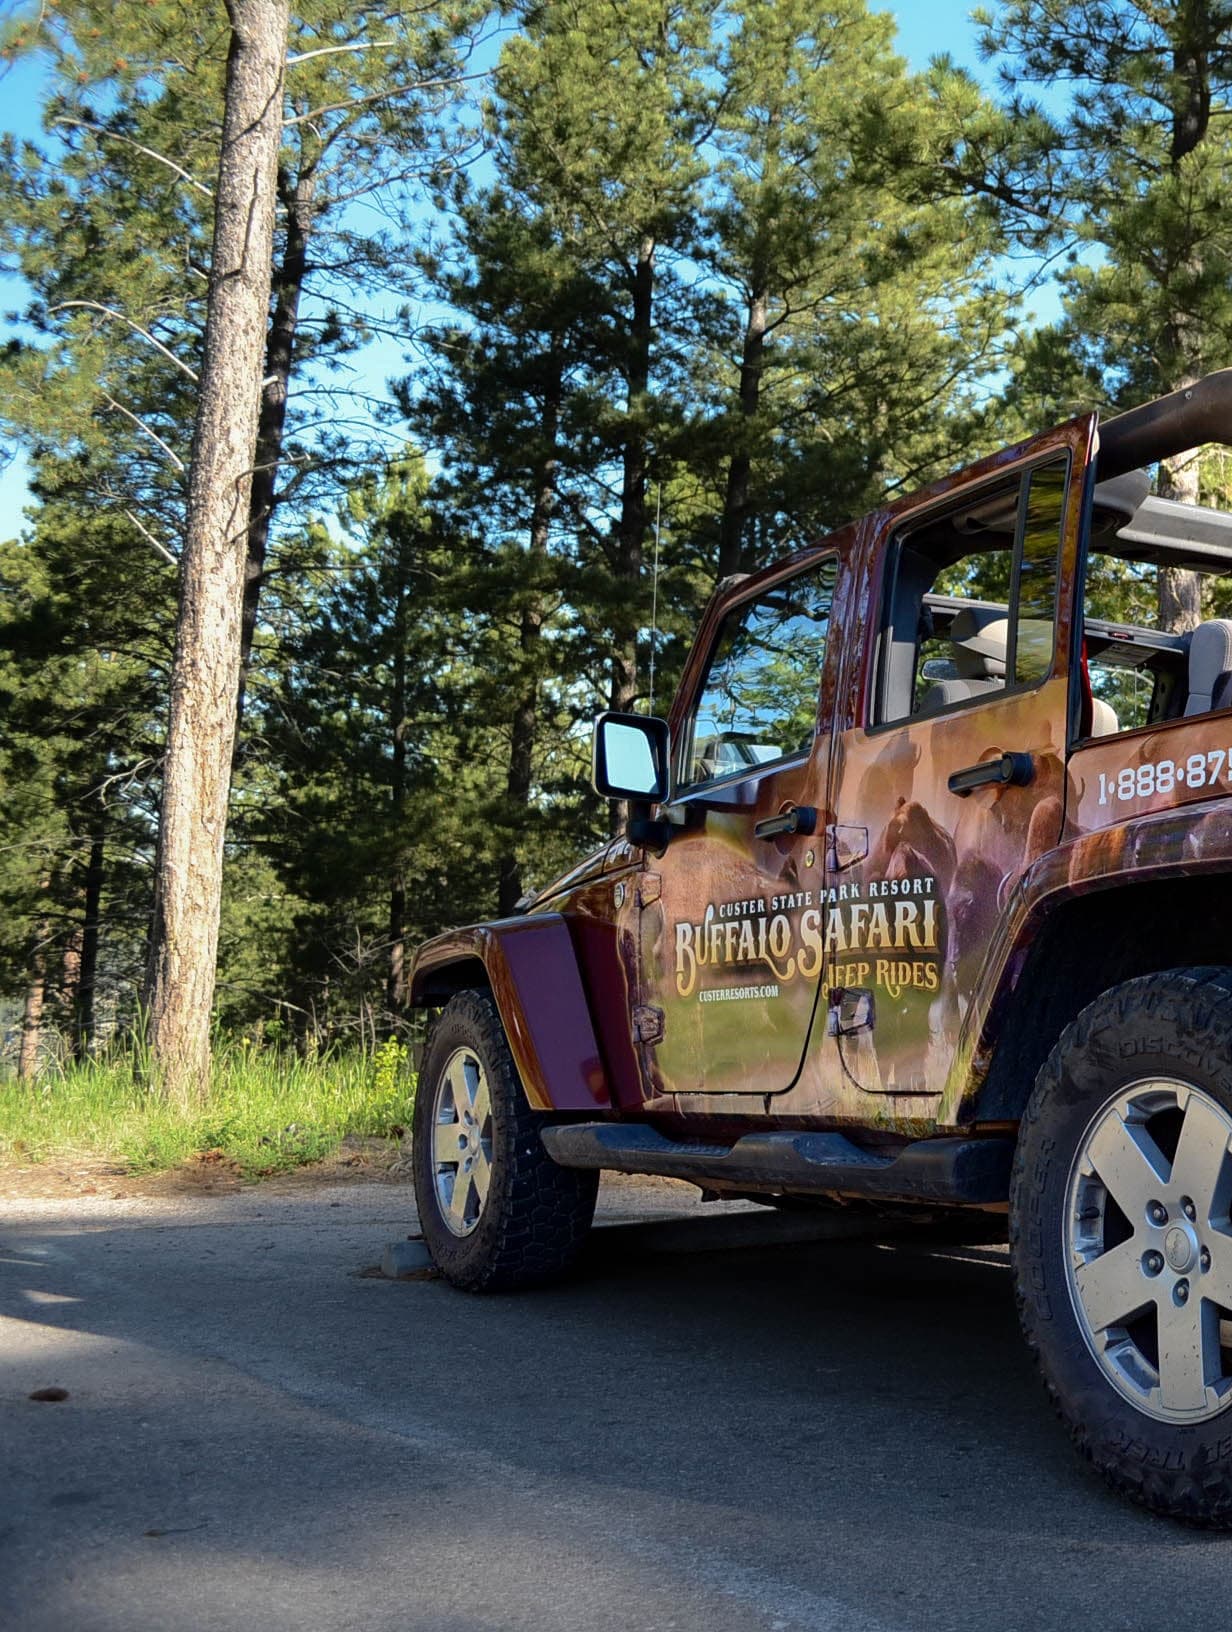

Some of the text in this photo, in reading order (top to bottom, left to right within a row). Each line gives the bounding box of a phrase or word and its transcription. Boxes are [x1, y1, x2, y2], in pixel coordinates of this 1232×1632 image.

[720, 877, 934, 918] CUSTER STATE PARK RESORT
[676, 900, 936, 997] BUFFALO SAFARI
[699, 985, 779, 1002] CUSTERRESORTS.COM
[822, 959, 938, 1000] JEEP RIDES
